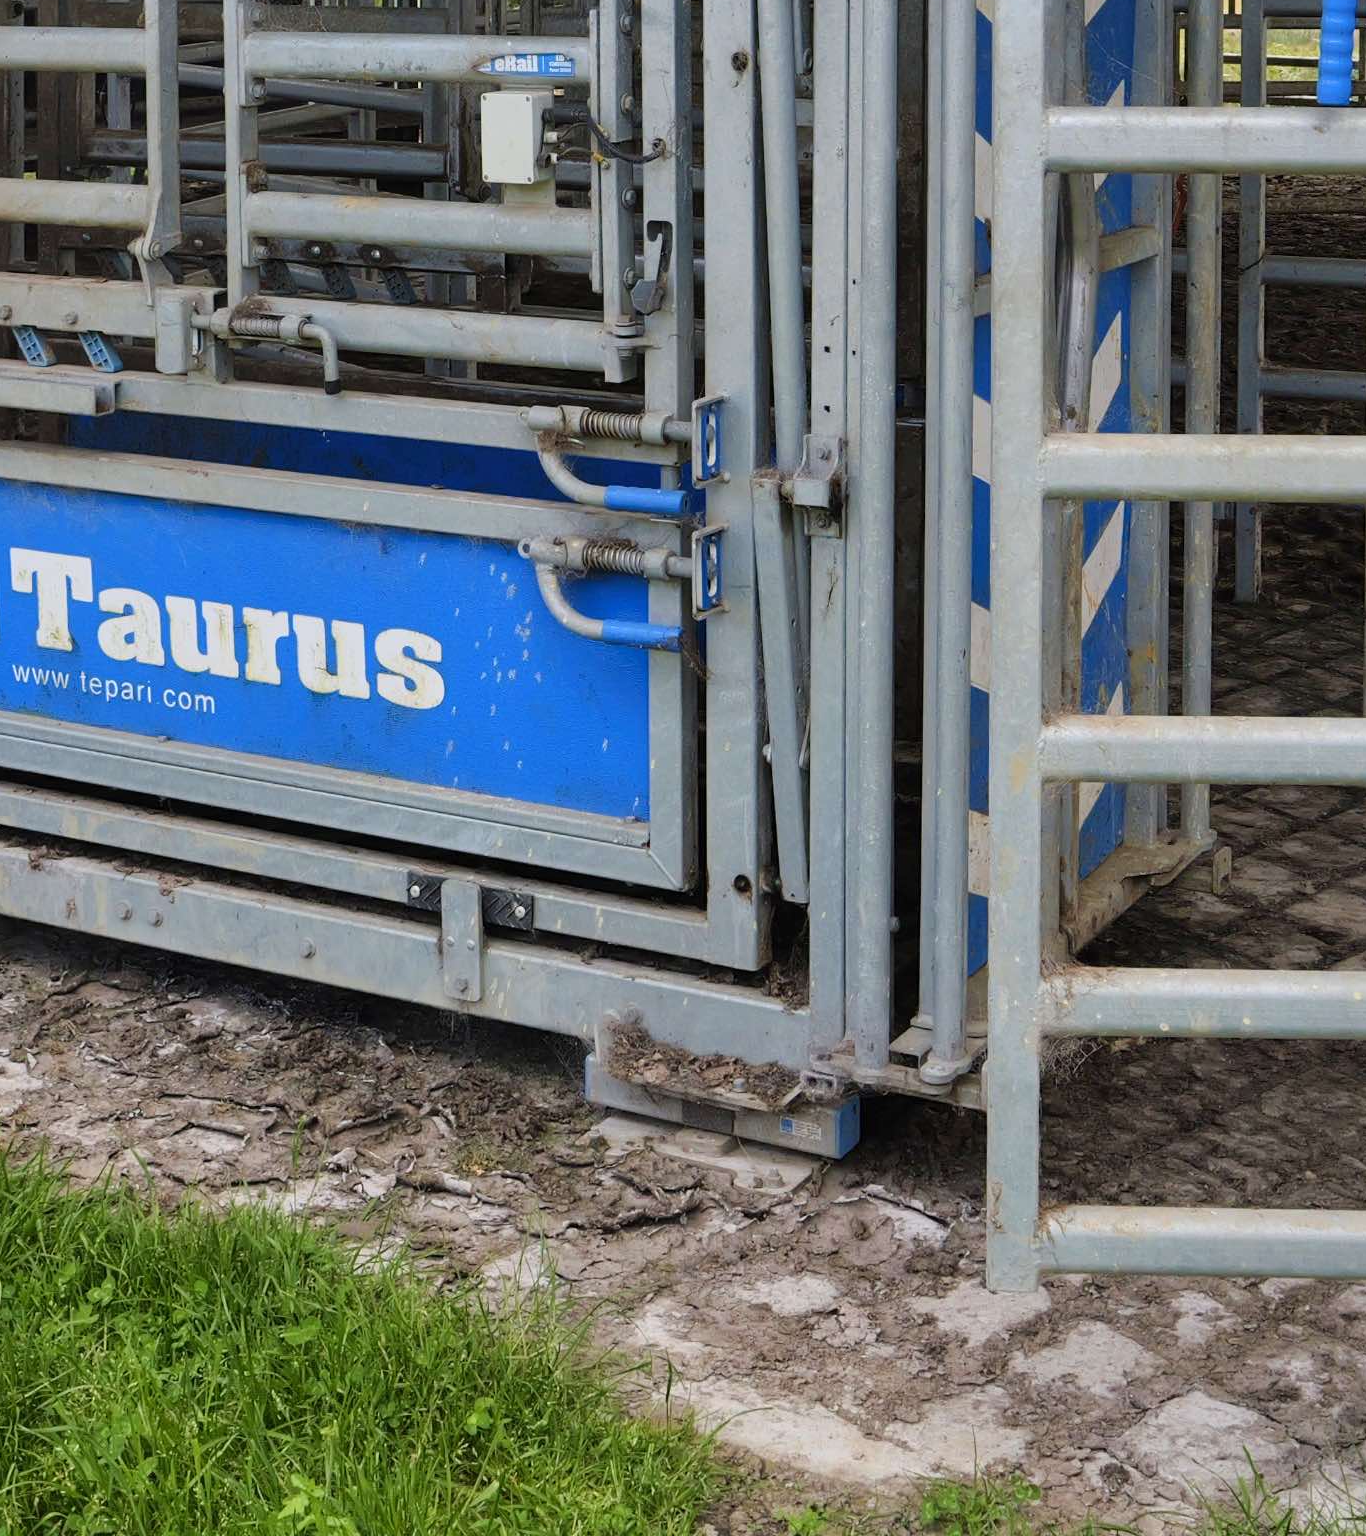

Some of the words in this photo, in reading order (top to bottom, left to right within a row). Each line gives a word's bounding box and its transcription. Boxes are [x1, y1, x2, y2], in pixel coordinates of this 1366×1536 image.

[495, 55, 538, 72] eRail
[10, 547, 446, 710] Taurus
[11, 664, 216, 714] wwwtepari.com
